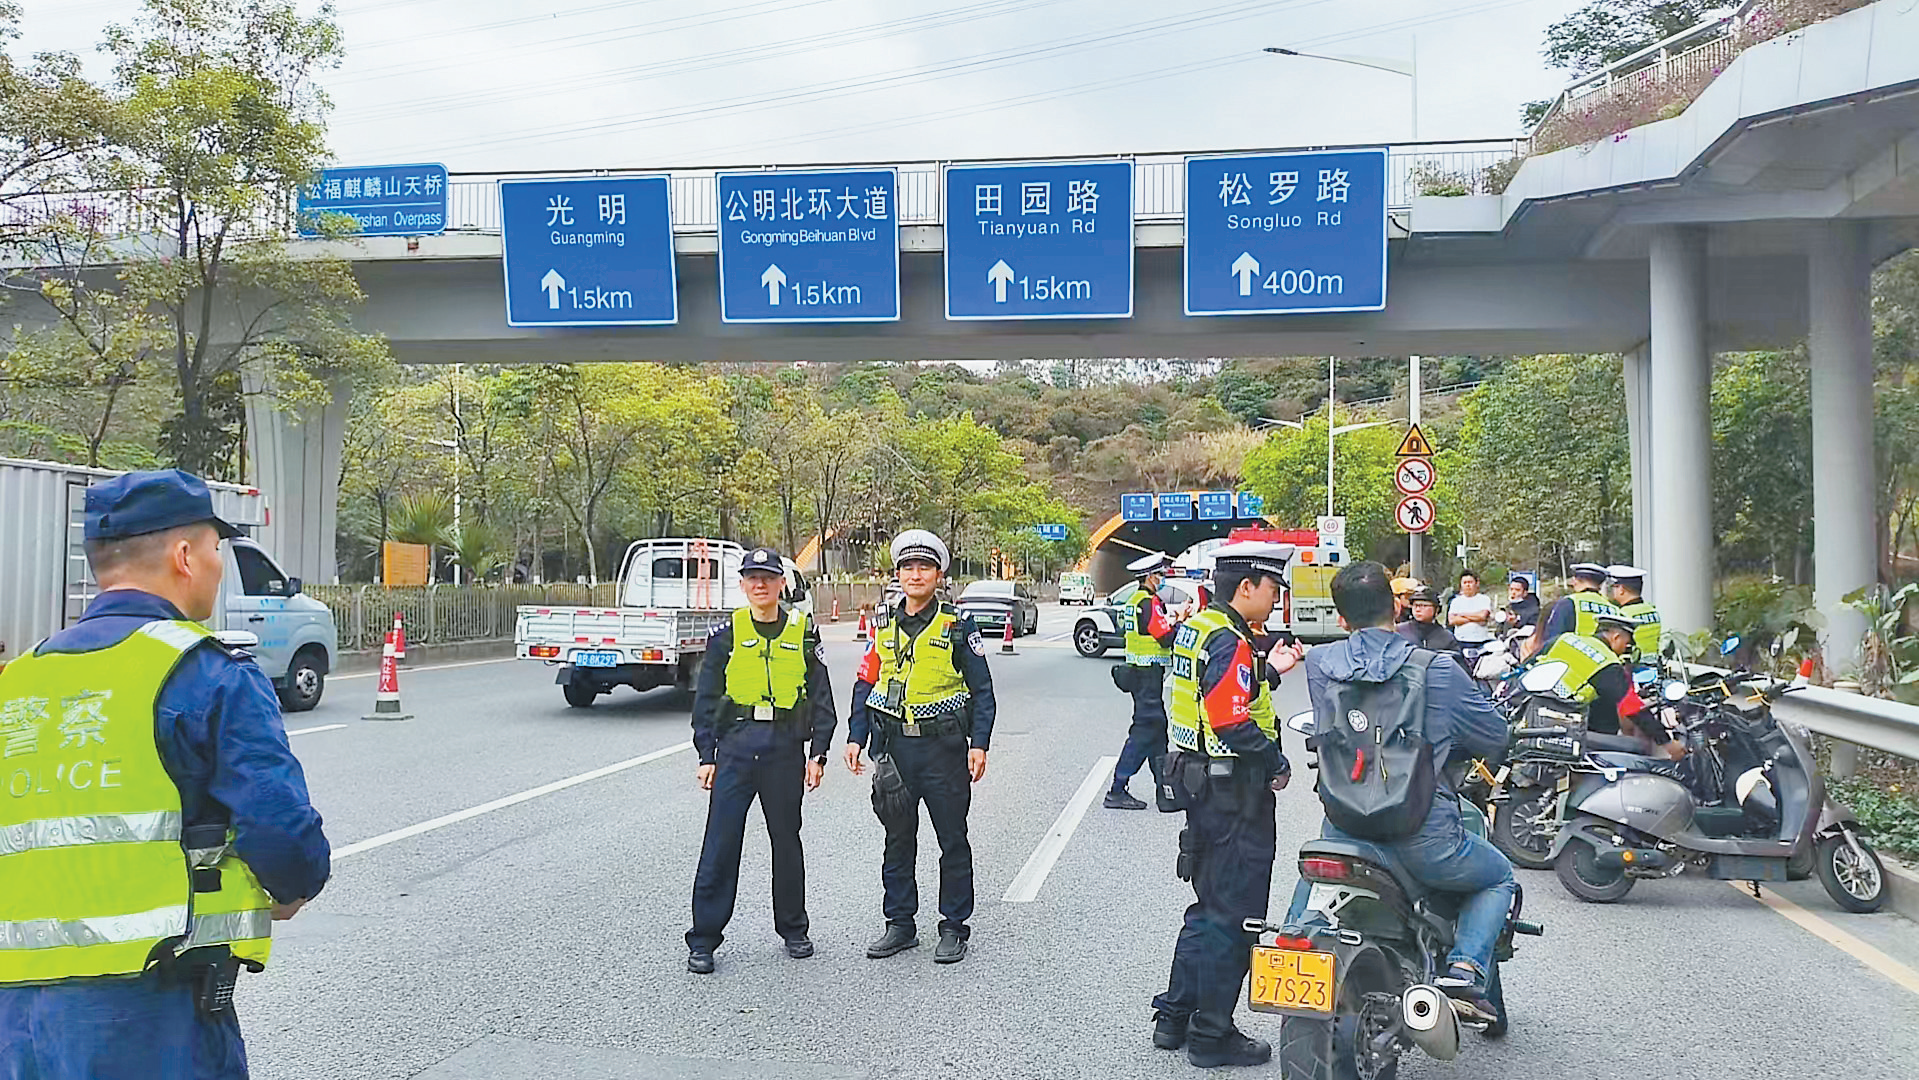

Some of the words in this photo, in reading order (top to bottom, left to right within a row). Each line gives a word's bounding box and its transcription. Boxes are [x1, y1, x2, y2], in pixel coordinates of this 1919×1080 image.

[975, 179, 1100, 217] 田园路
[1218, 168, 1351, 207] 松罗路
[546, 194, 626, 227] 光明
[725, 186, 889, 223] 公明北环大道
[394, 211, 441, 229] Overpass
[978, 221, 1060, 238] Tianyuan
[1072, 219, 1096, 234] Rd
[1227, 213, 1302, 232] Songluo
[1317, 211, 1341, 226] Rd
[551, 231, 625, 247] Guangming
[848, 228, 876, 242] Blvd
[791, 281, 862, 306] 1.5km
[1019, 275, 1091, 300] 1.5km
[1263, 269, 1343, 294] 400m
[568, 286, 633, 310] 1.5km
[0, 689, 112, 759] 警察
[0, 757, 121, 798] OLICE
[1256, 975, 1326, 1006] 97S23
